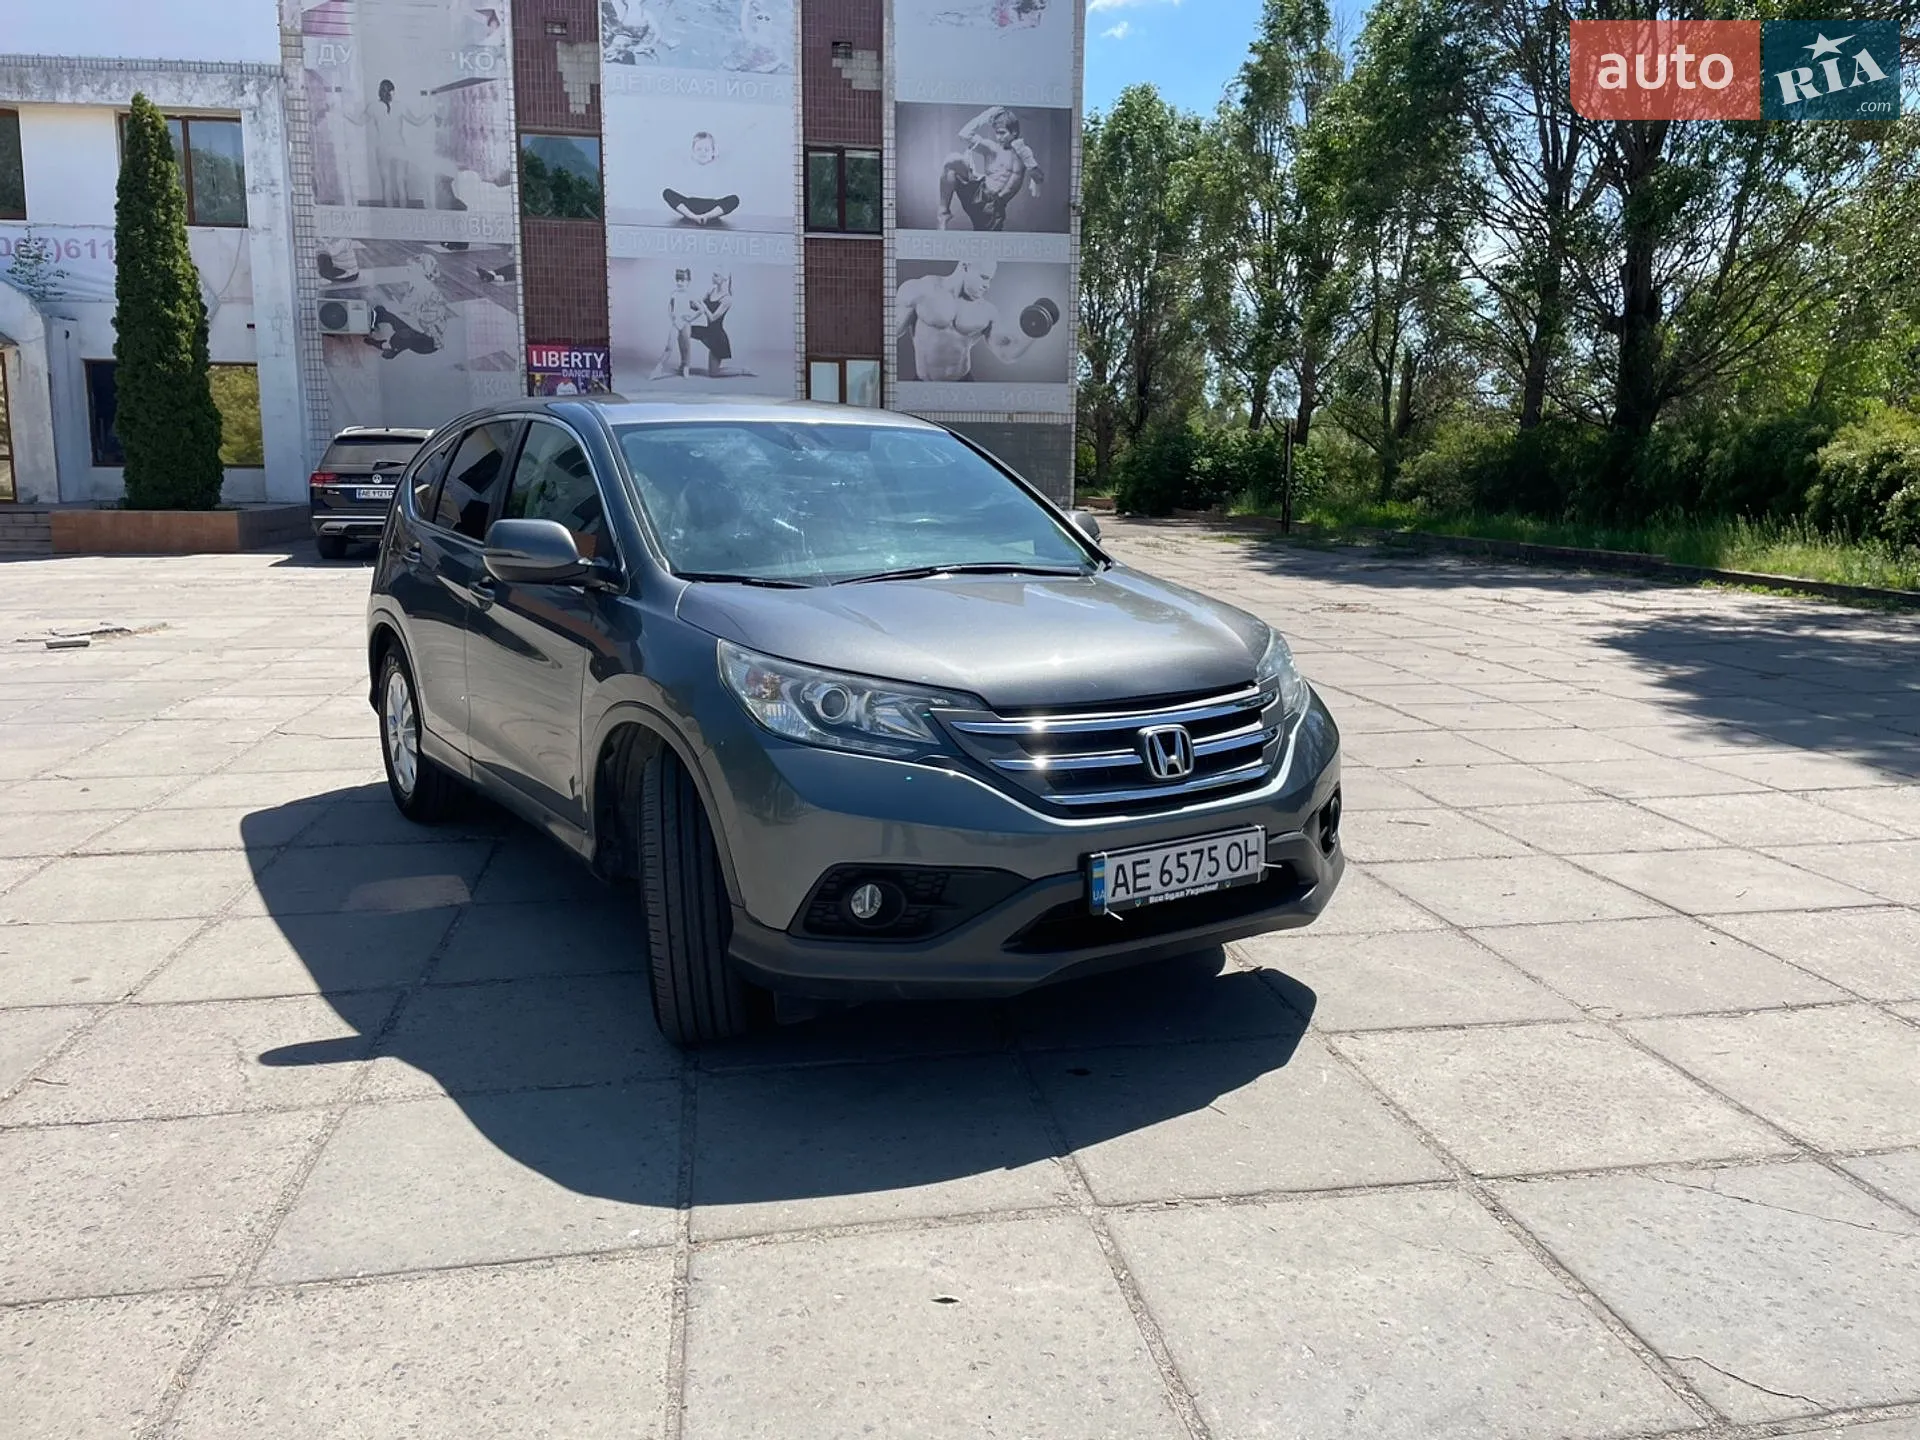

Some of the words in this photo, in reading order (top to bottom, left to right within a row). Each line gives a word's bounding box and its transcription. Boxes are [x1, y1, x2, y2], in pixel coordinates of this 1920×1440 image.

[610, 73, 718, 97] ДЕТСКАЯ
[726, 78, 786, 100] ЙОГА
[614, 231, 698, 254] СТУДИЯ
[705, 234, 788, 257] БАЛЕТА
[532, 351, 605, 369] LIBERTY
[1111, 858, 1151, 898] AE
[1159, 845, 1220, 887] 6575
[1226, 838, 1260, 872] OH
